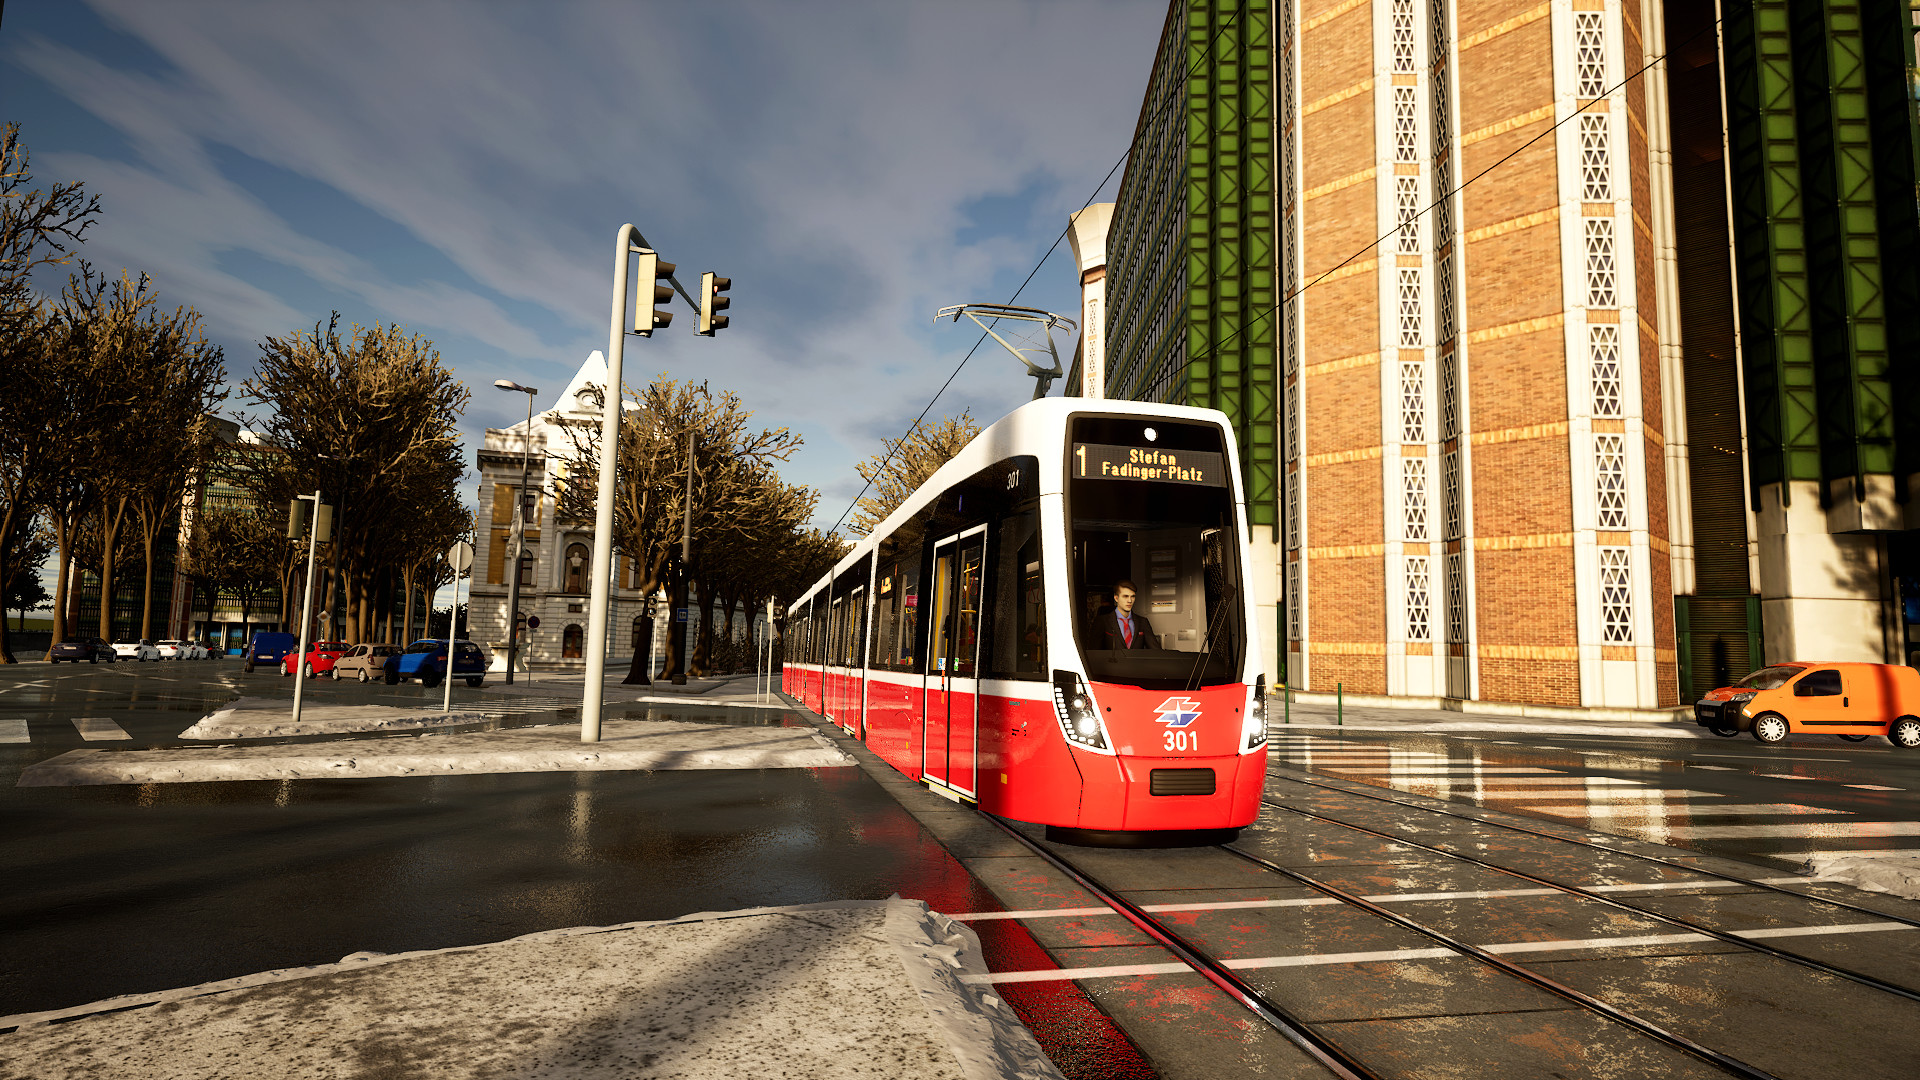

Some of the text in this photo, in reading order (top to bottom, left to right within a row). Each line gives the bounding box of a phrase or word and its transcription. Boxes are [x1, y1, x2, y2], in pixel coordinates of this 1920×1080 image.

[1076, 445, 1087, 477] 1
[1129, 448, 1177, 466] Stefan
[1006, 469, 1020, 491] 301
[1102, 461, 1203, 482] Fadinger-Platz
[1162, 730, 1198, 752] 301
